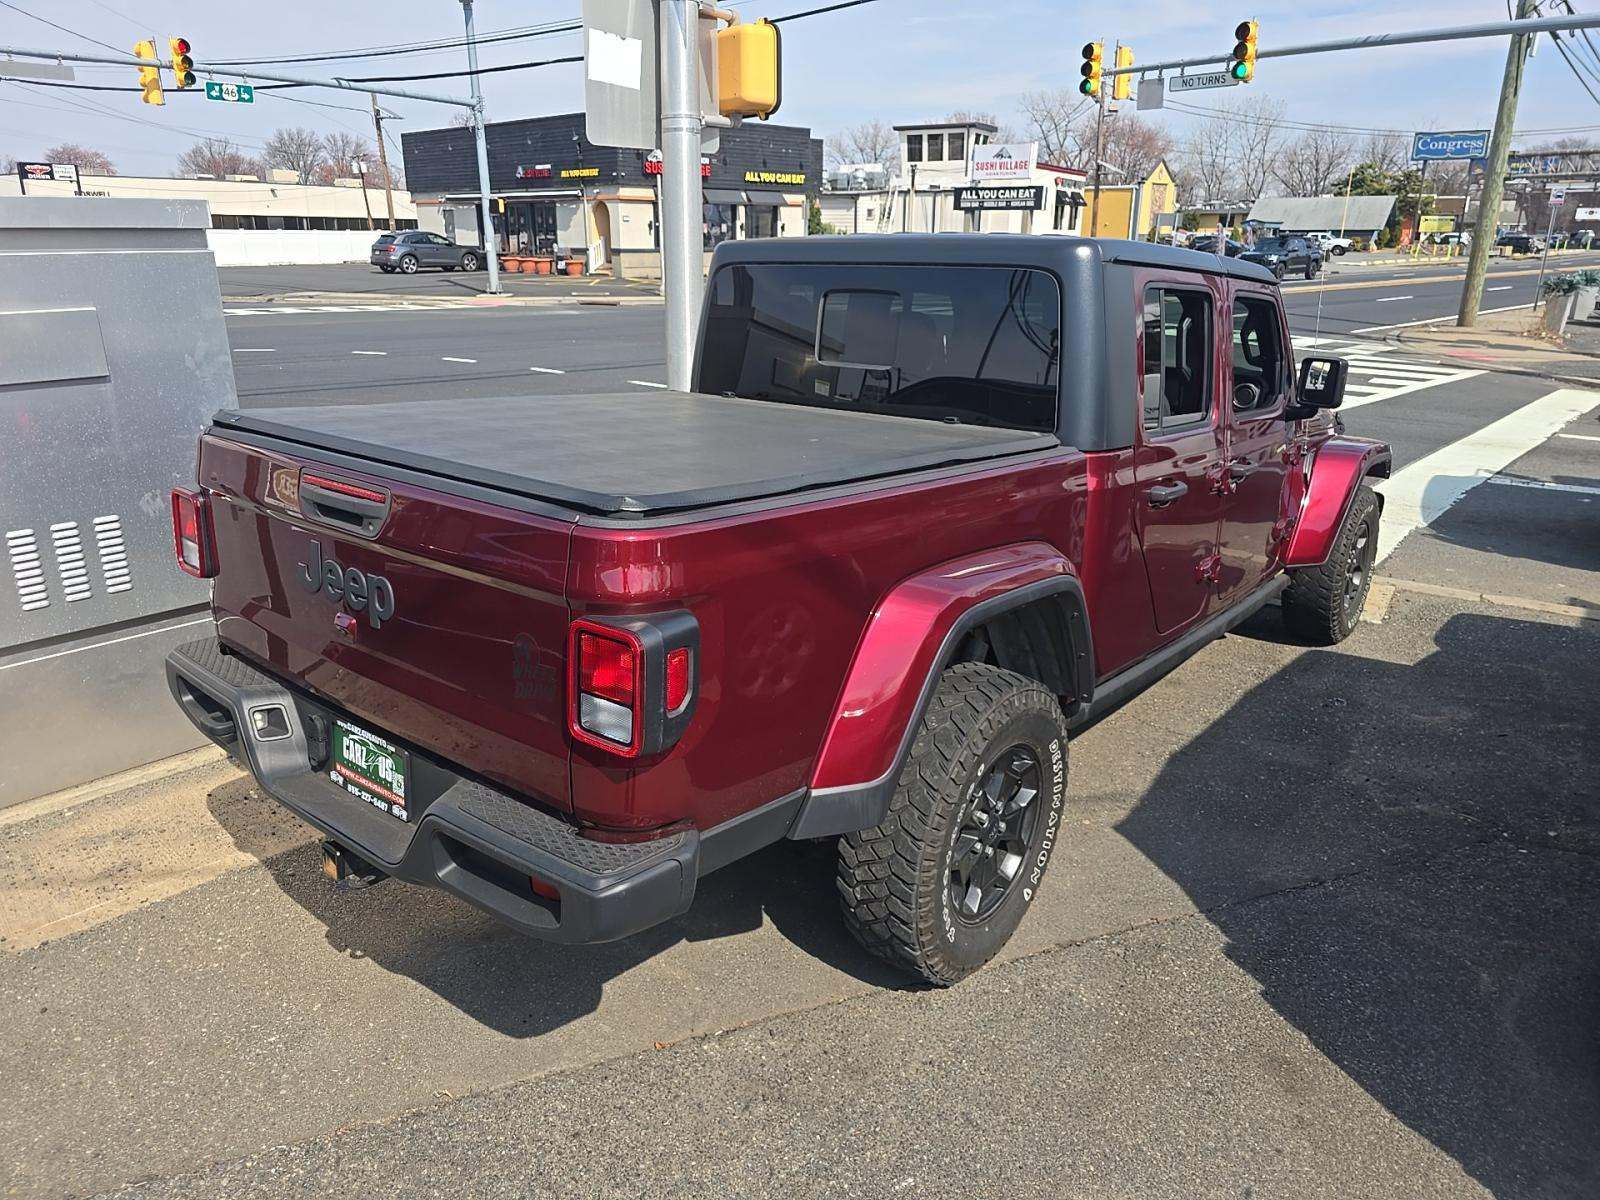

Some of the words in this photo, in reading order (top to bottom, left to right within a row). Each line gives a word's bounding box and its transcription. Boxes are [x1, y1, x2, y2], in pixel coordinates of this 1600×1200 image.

[1181, 78, 1194, 88] NO
[1197, 74, 1226, 87] TURNS
[224, 87, 237, 98] 46
[1418, 137, 1484, 151] Congress
[975, 161, 998, 171] SUSHI
[998, 160, 1029, 170] VILLAGE
[745, 171, 760, 182] ALL
[760, 172, 776, 183] YOU
[776, 173, 792, 184] CAN
[792, 174, 806, 184] EAT
[961, 190, 977, 199] ALL
[978, 189, 997, 199] YOU
[998, 189, 1017, 198] CAN
[1018, 189, 1036, 198] EAT
[297, 539, 395, 629] Jeep
[1030, 738, 1064, 885] DESTINATION
